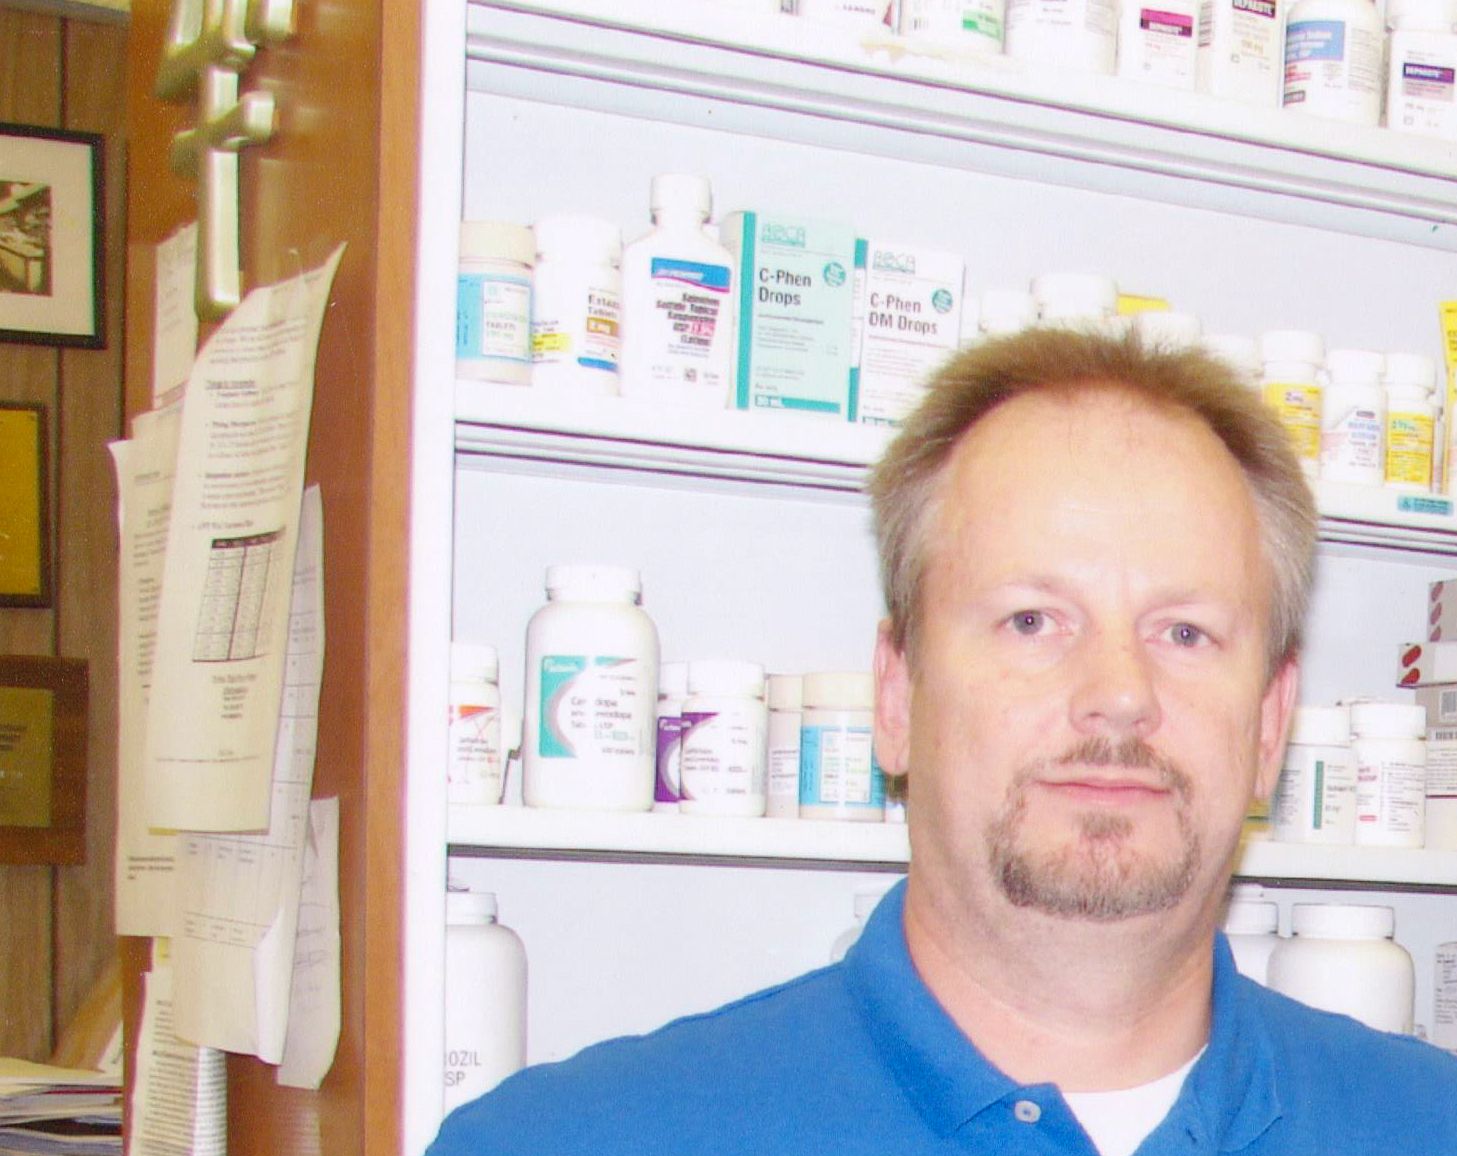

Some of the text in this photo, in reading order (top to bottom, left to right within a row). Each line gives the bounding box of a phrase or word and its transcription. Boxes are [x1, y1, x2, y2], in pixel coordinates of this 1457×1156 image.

[759, 267, 812, 287] C-Phen
[759, 286, 801, 307] Drops
[870, 292, 922, 313] C-Phen
[869, 312, 938, 335] DM Drops
